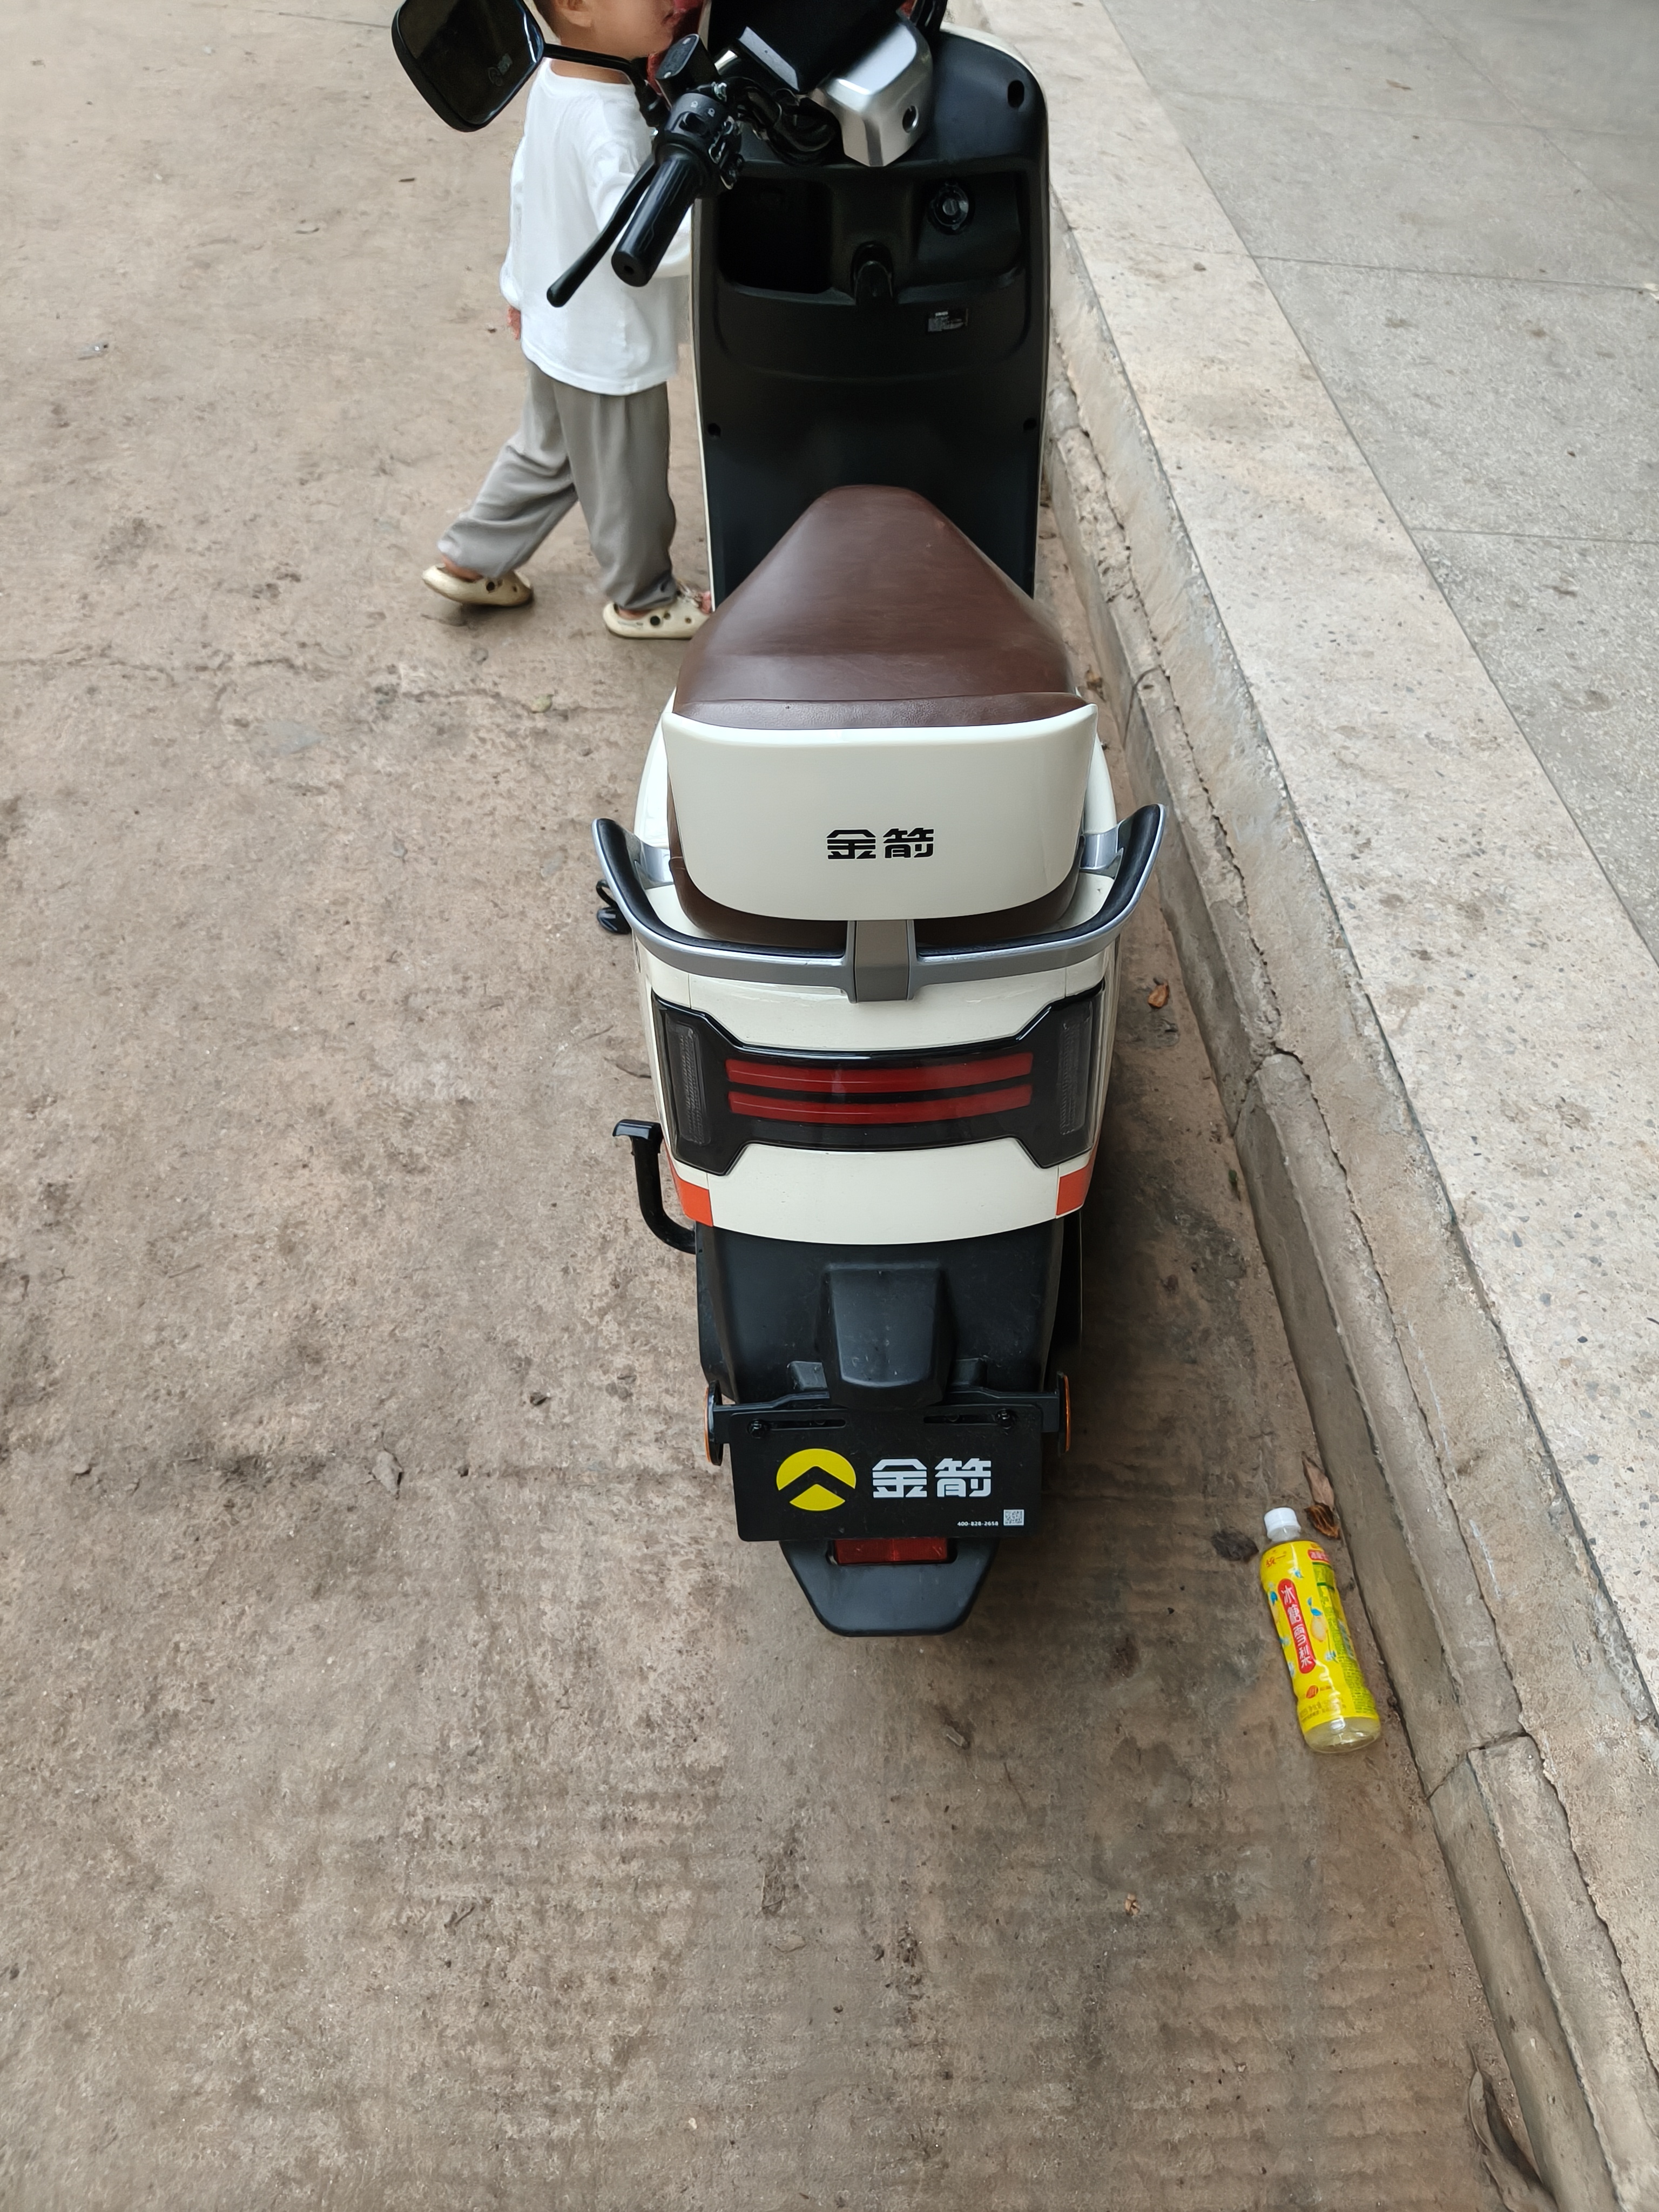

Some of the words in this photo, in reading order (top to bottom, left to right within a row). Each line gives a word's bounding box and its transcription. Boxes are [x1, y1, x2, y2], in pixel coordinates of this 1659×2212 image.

[826, 827, 934, 859] 金箭
[872, 1458, 992, 1498] 金箭
[1280, 1584, 1313, 1669] 冰糖雪梨
